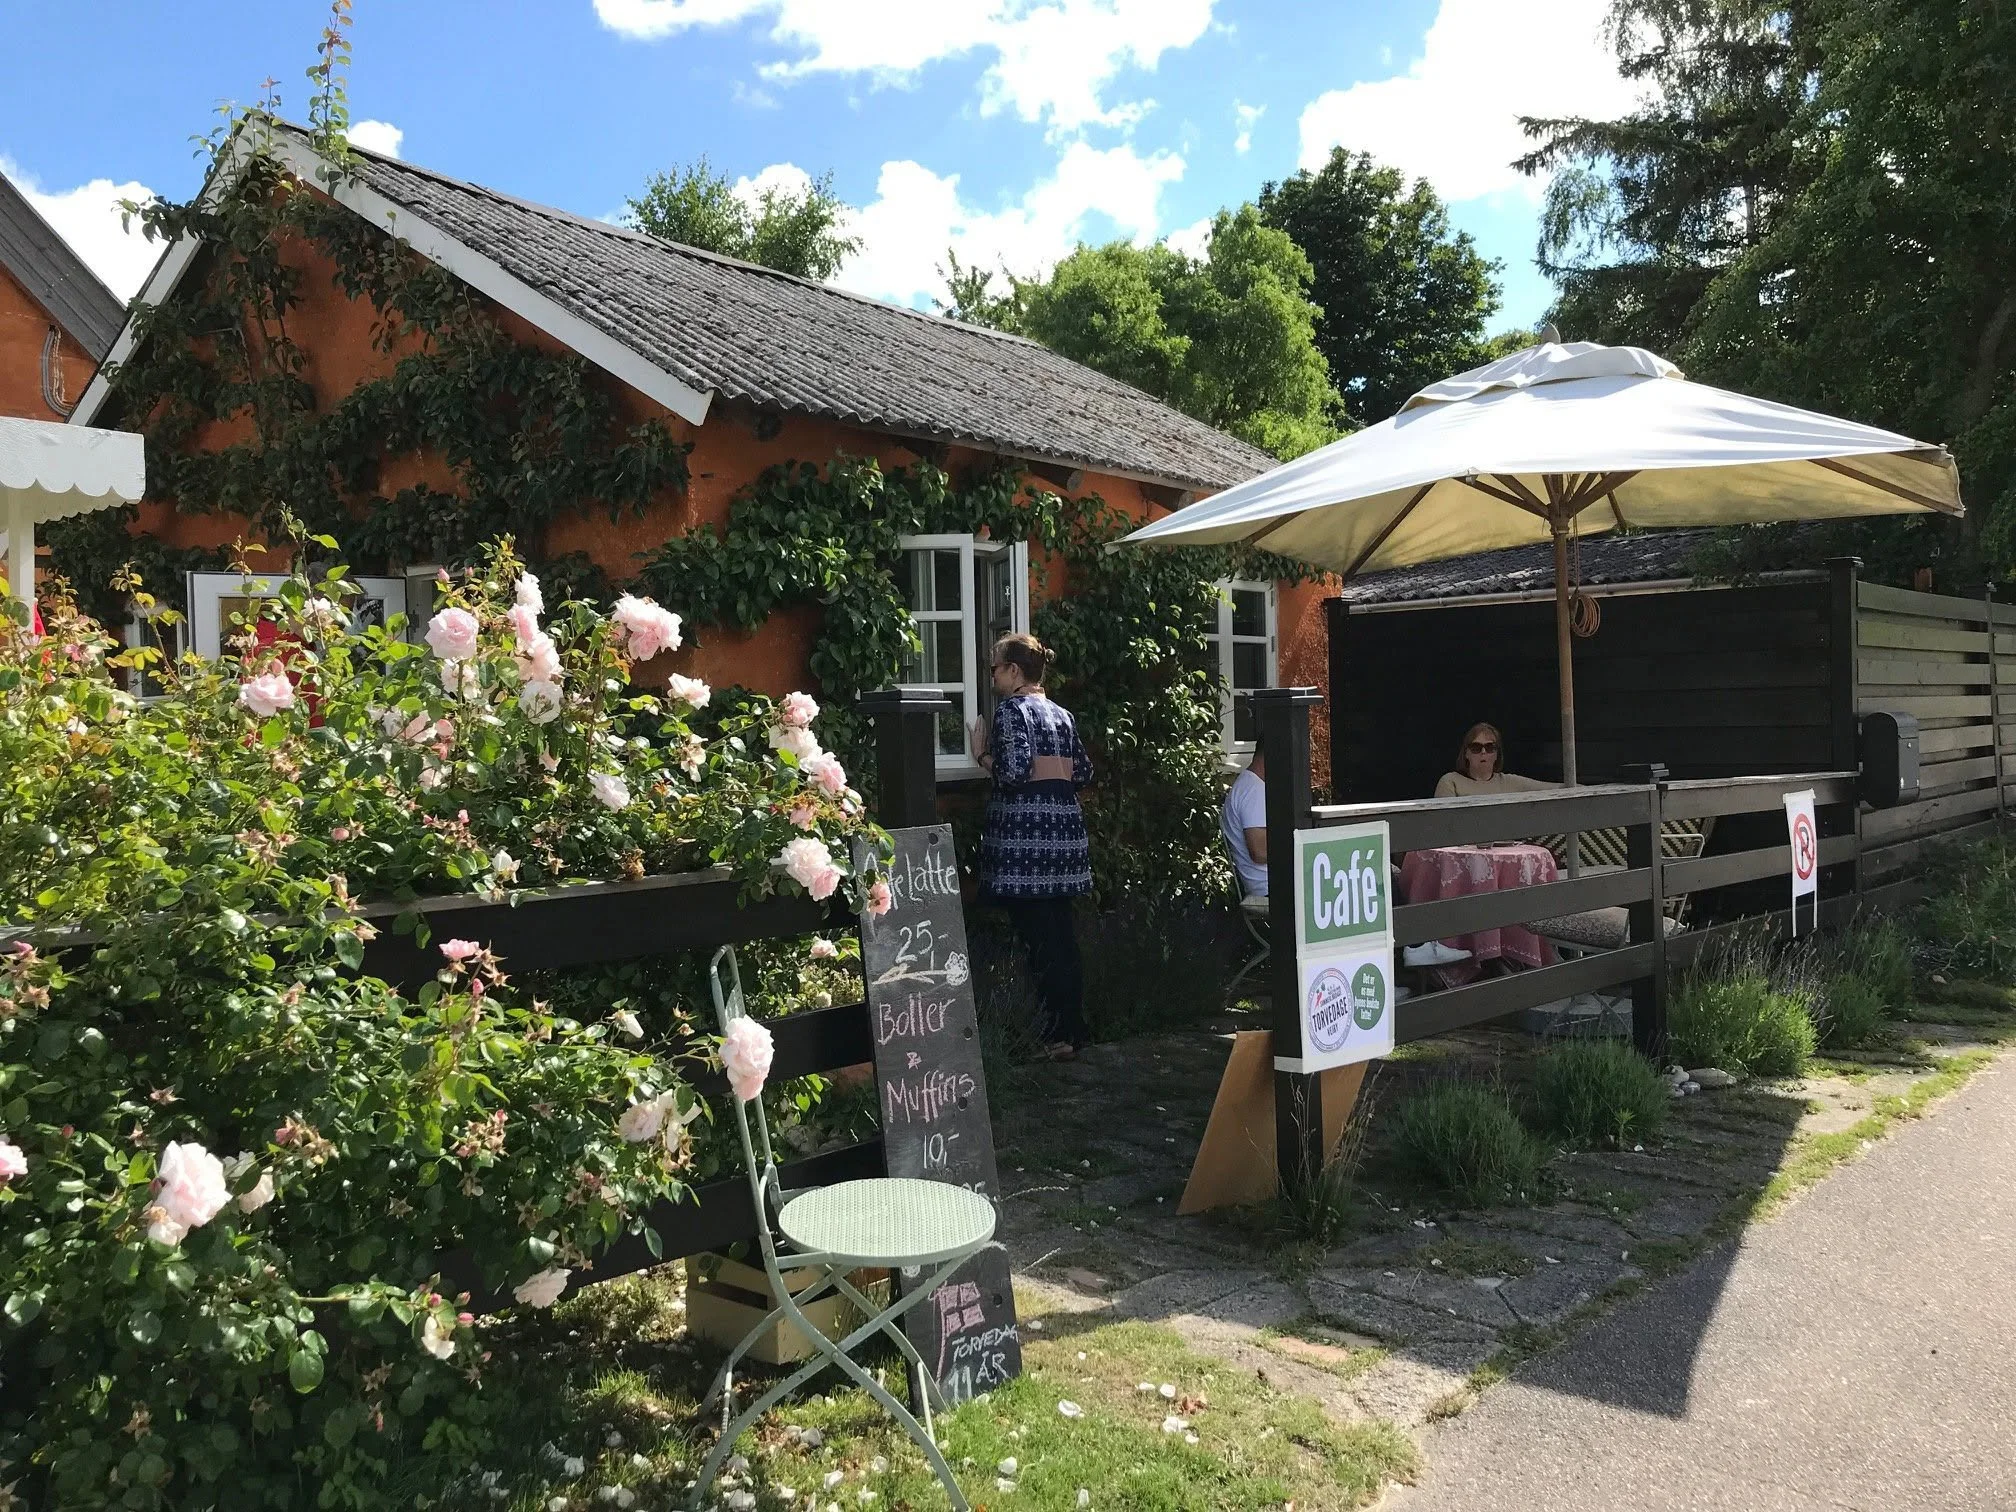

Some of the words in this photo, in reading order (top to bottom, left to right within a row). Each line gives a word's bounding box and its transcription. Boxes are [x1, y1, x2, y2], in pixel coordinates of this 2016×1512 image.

[1312, 849, 1379, 930] Café
[878, 991, 955, 1046] Boller
[1312, 997, 1348, 1033] TORVEDAGE
[886, 1069, 976, 1124] Muffins
